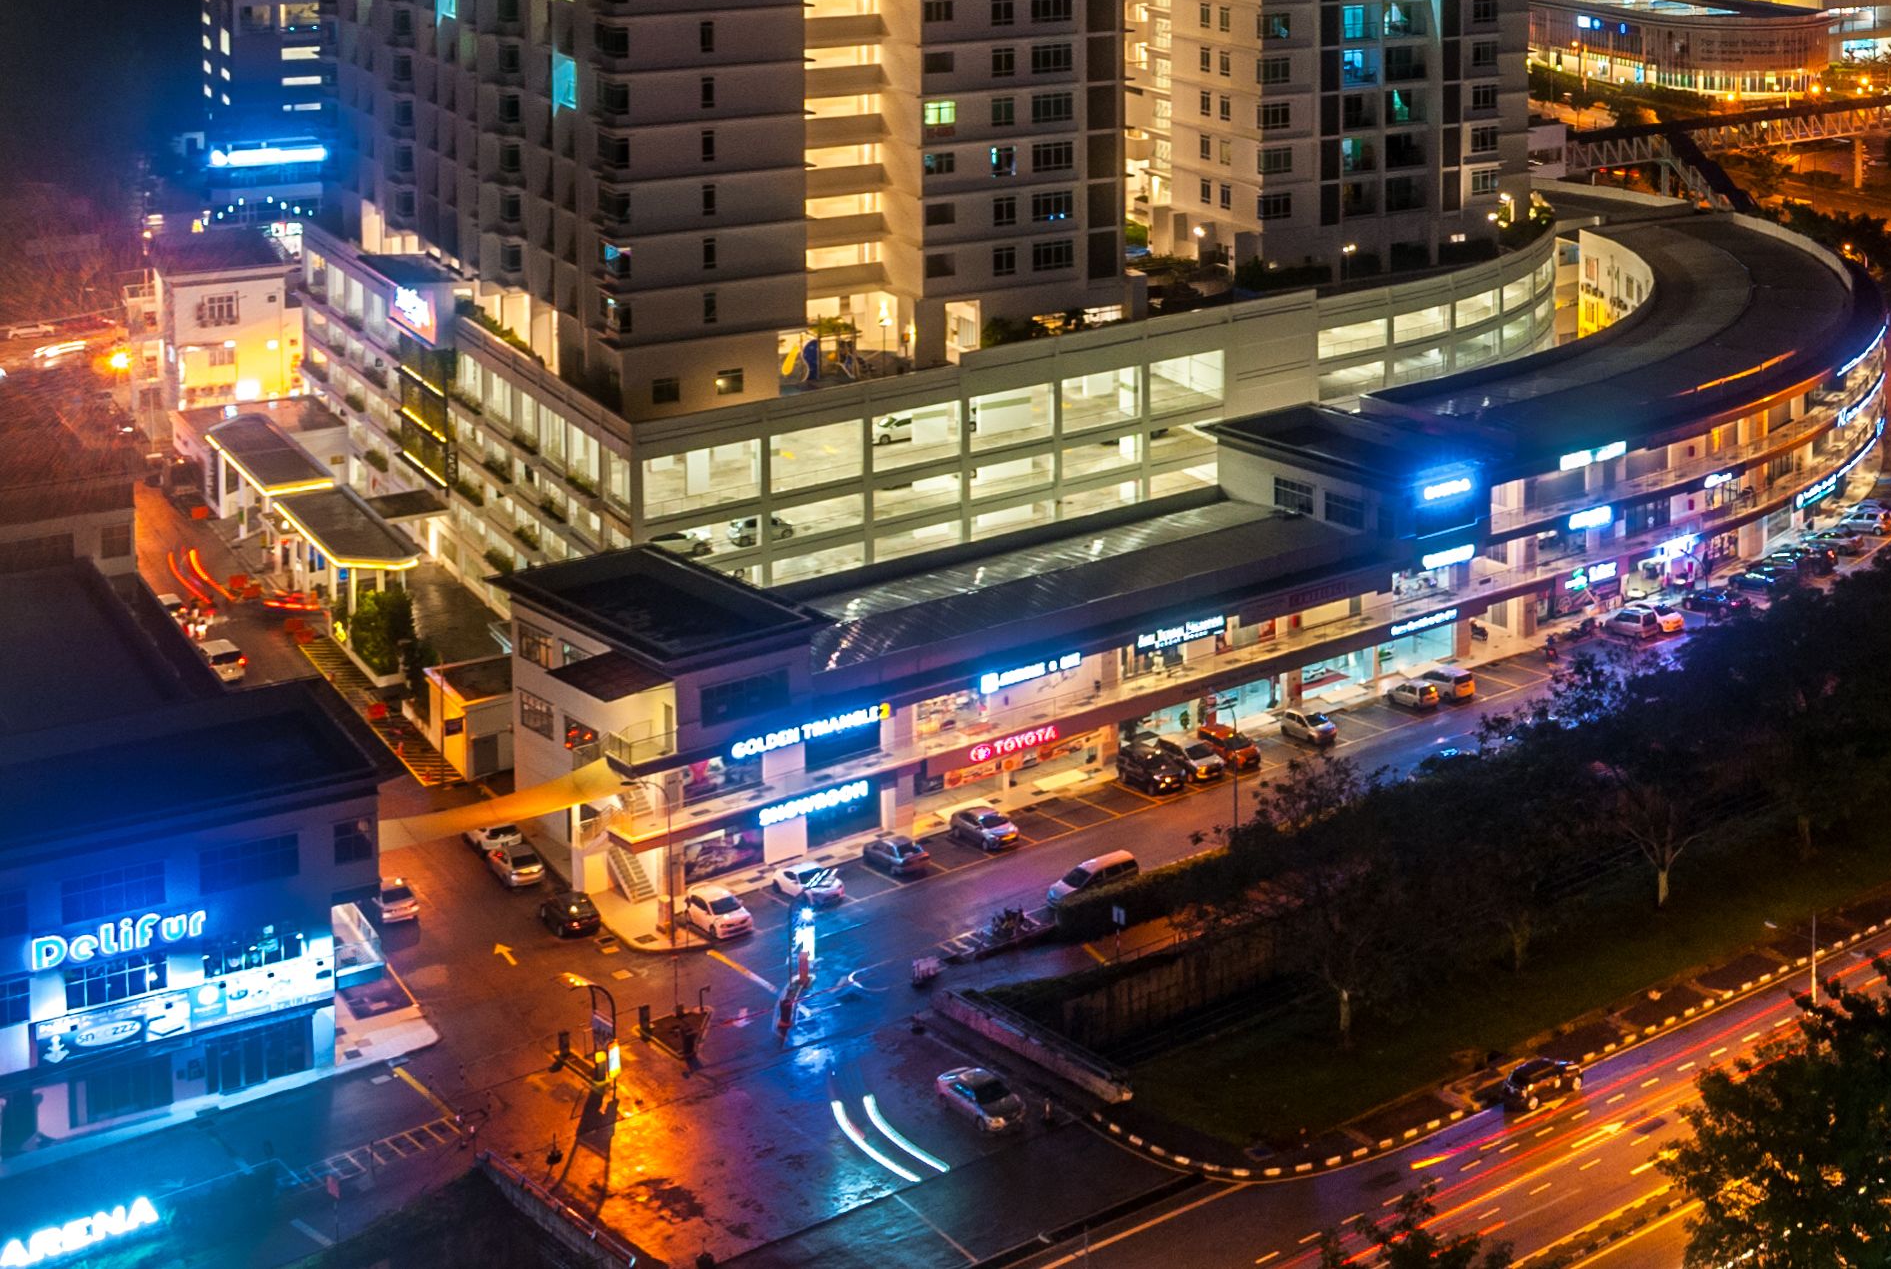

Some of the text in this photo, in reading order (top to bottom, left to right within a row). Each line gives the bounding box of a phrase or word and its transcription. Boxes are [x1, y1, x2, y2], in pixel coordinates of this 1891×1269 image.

[731, 703, 891, 759] GOLDEN TRIANGLE 2
[993, 725, 1058, 754] TOYOTA
[759, 780, 869, 826] SHOWROOM
[0, 1196, 160, 1267] ARENA
